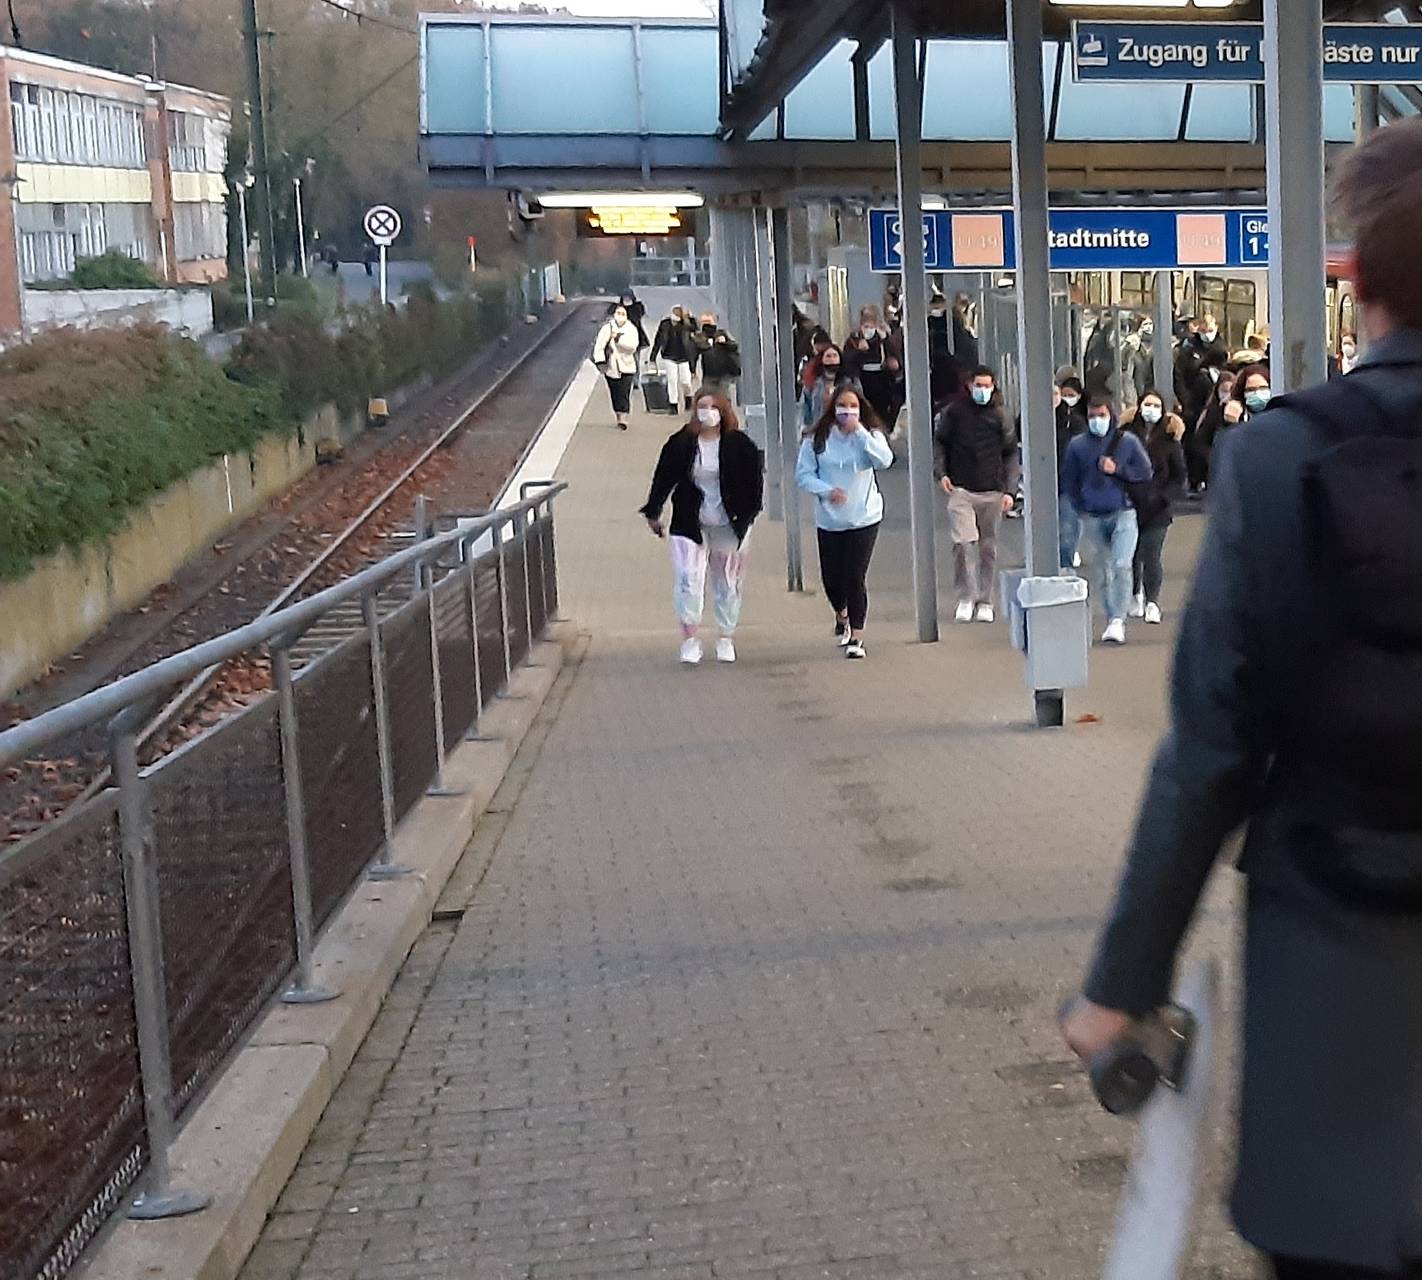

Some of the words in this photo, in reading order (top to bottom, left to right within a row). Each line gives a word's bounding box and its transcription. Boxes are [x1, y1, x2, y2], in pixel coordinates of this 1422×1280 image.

[1118, 38, 1207, 67] Zugang
[1216, 39, 1250, 61] für
[1381, 45, 1420, 62] nur
[1048, 228, 1150, 247] tadtmitte
